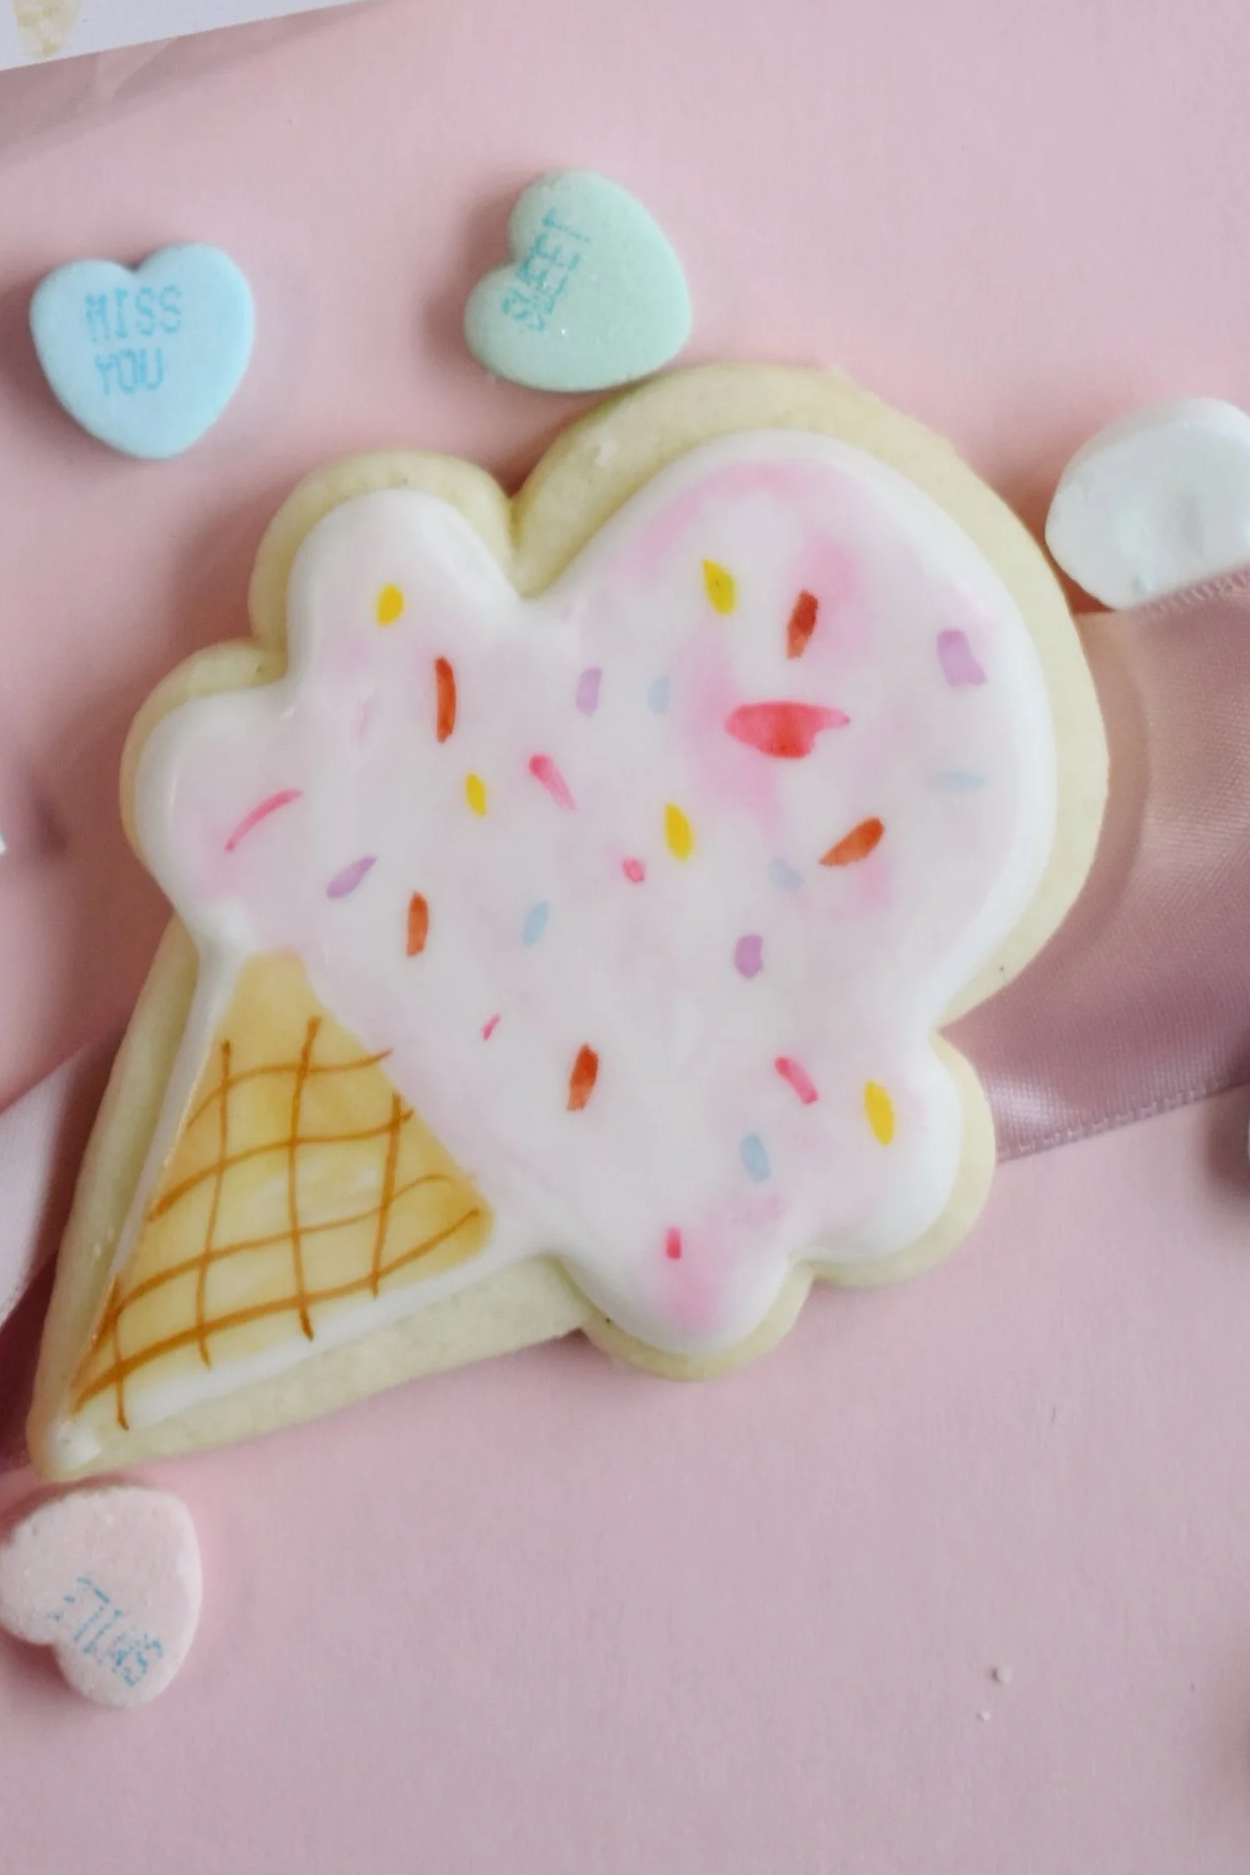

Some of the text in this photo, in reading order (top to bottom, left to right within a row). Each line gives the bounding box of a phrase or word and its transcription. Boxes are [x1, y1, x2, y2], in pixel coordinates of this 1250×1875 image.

[502, 207, 591, 332] SWEET
[84, 284, 183, 343] MISS
[94, 347, 164, 395] YOU
